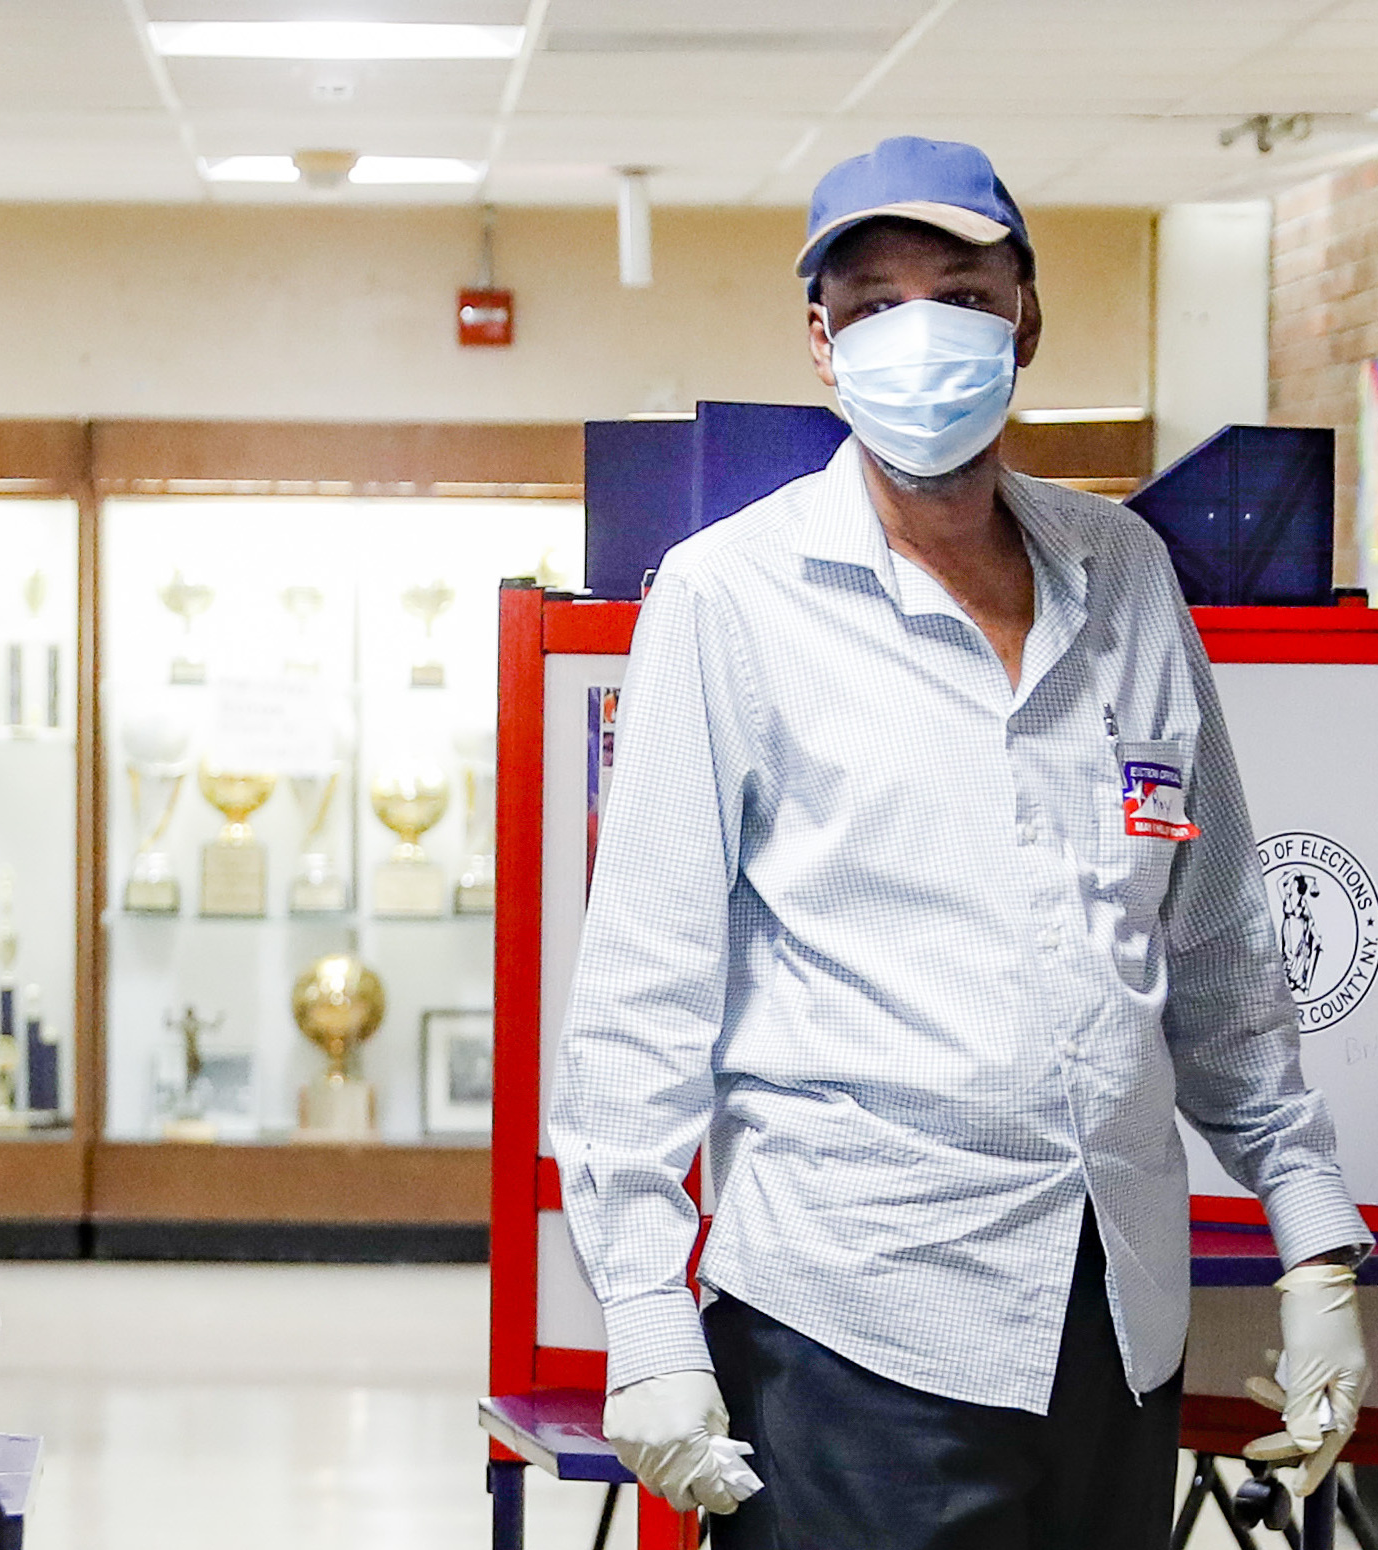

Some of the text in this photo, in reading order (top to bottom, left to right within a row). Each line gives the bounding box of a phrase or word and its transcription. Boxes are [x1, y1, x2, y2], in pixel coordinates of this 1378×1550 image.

[1274, 839, 1373, 911] OF ELECTIONS
[1310, 937, 1378, 1024] COUNTY N.Y.
